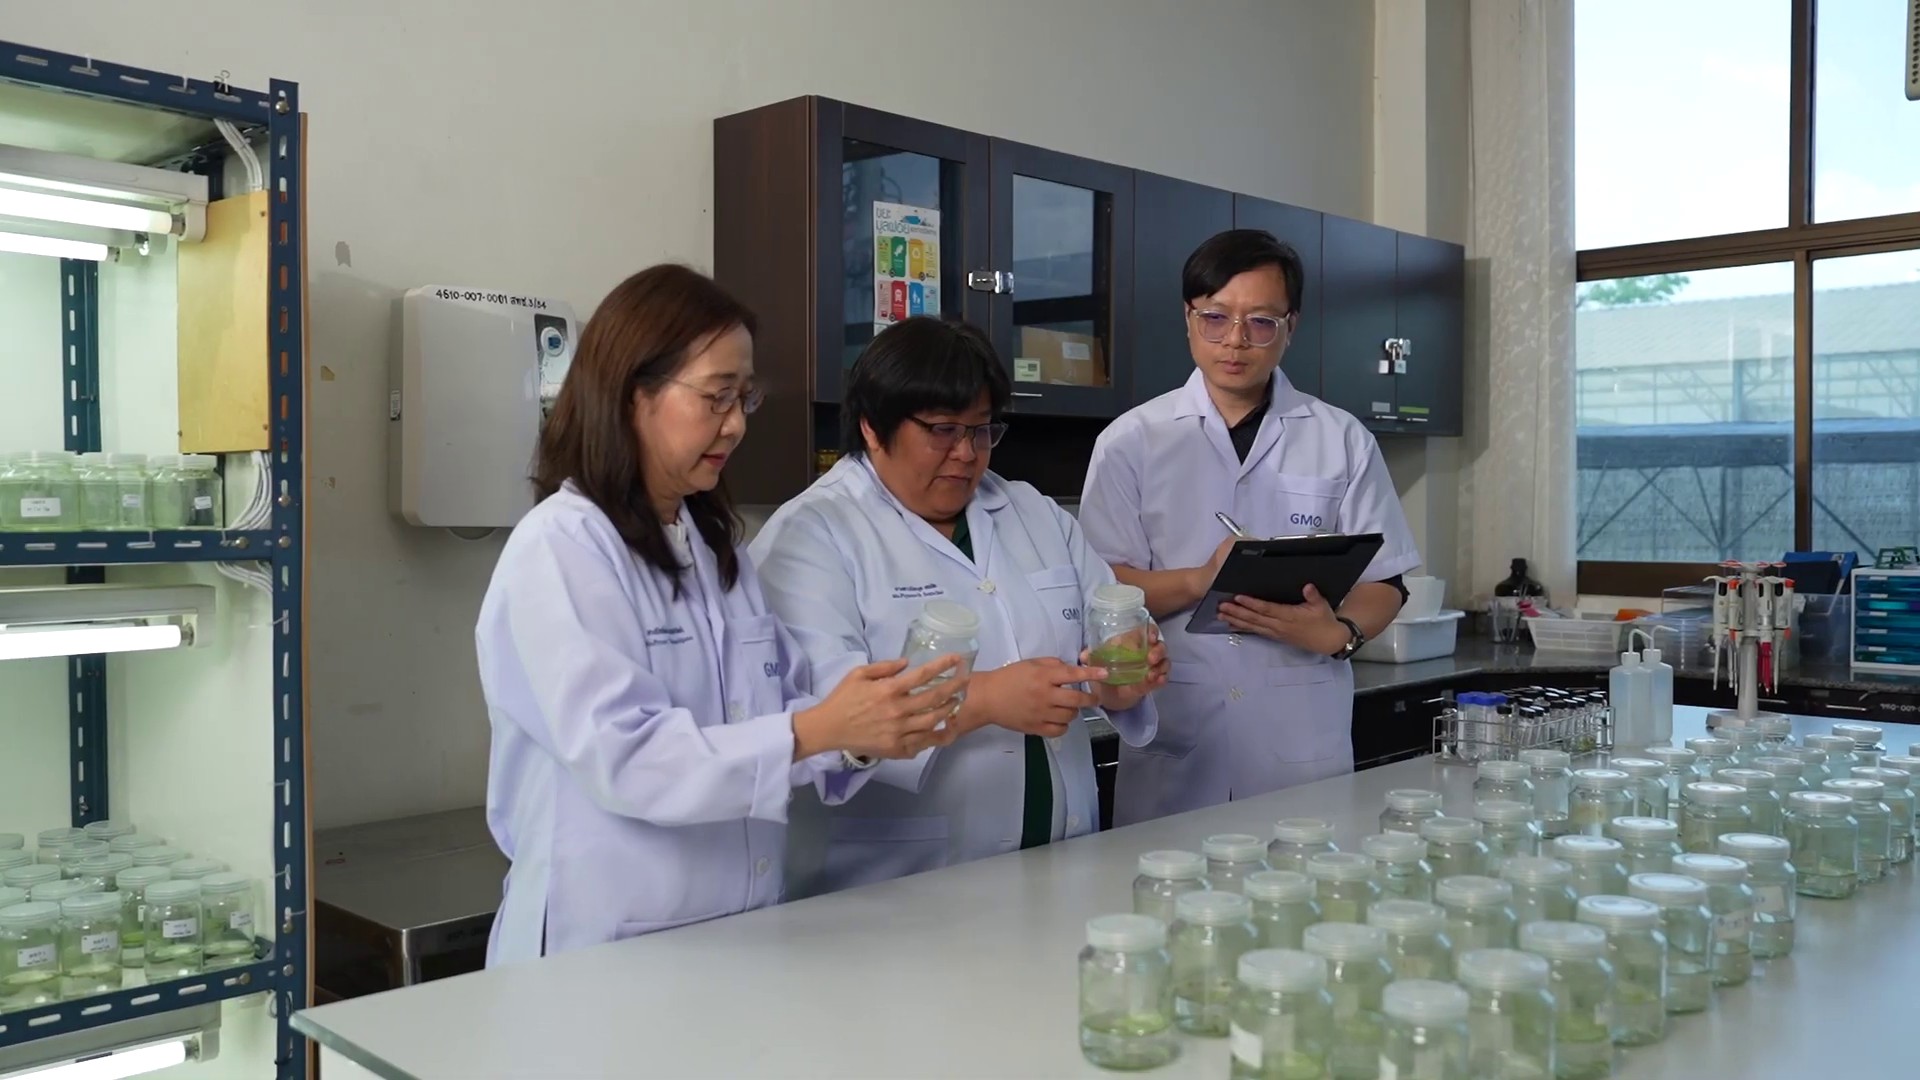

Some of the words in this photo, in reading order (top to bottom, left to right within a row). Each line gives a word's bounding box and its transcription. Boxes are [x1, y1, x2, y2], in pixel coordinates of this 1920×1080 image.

[1290, 513, 1322, 528] GMO
[1062, 608, 1081, 620] GM
[764, 661, 781, 678] GM
